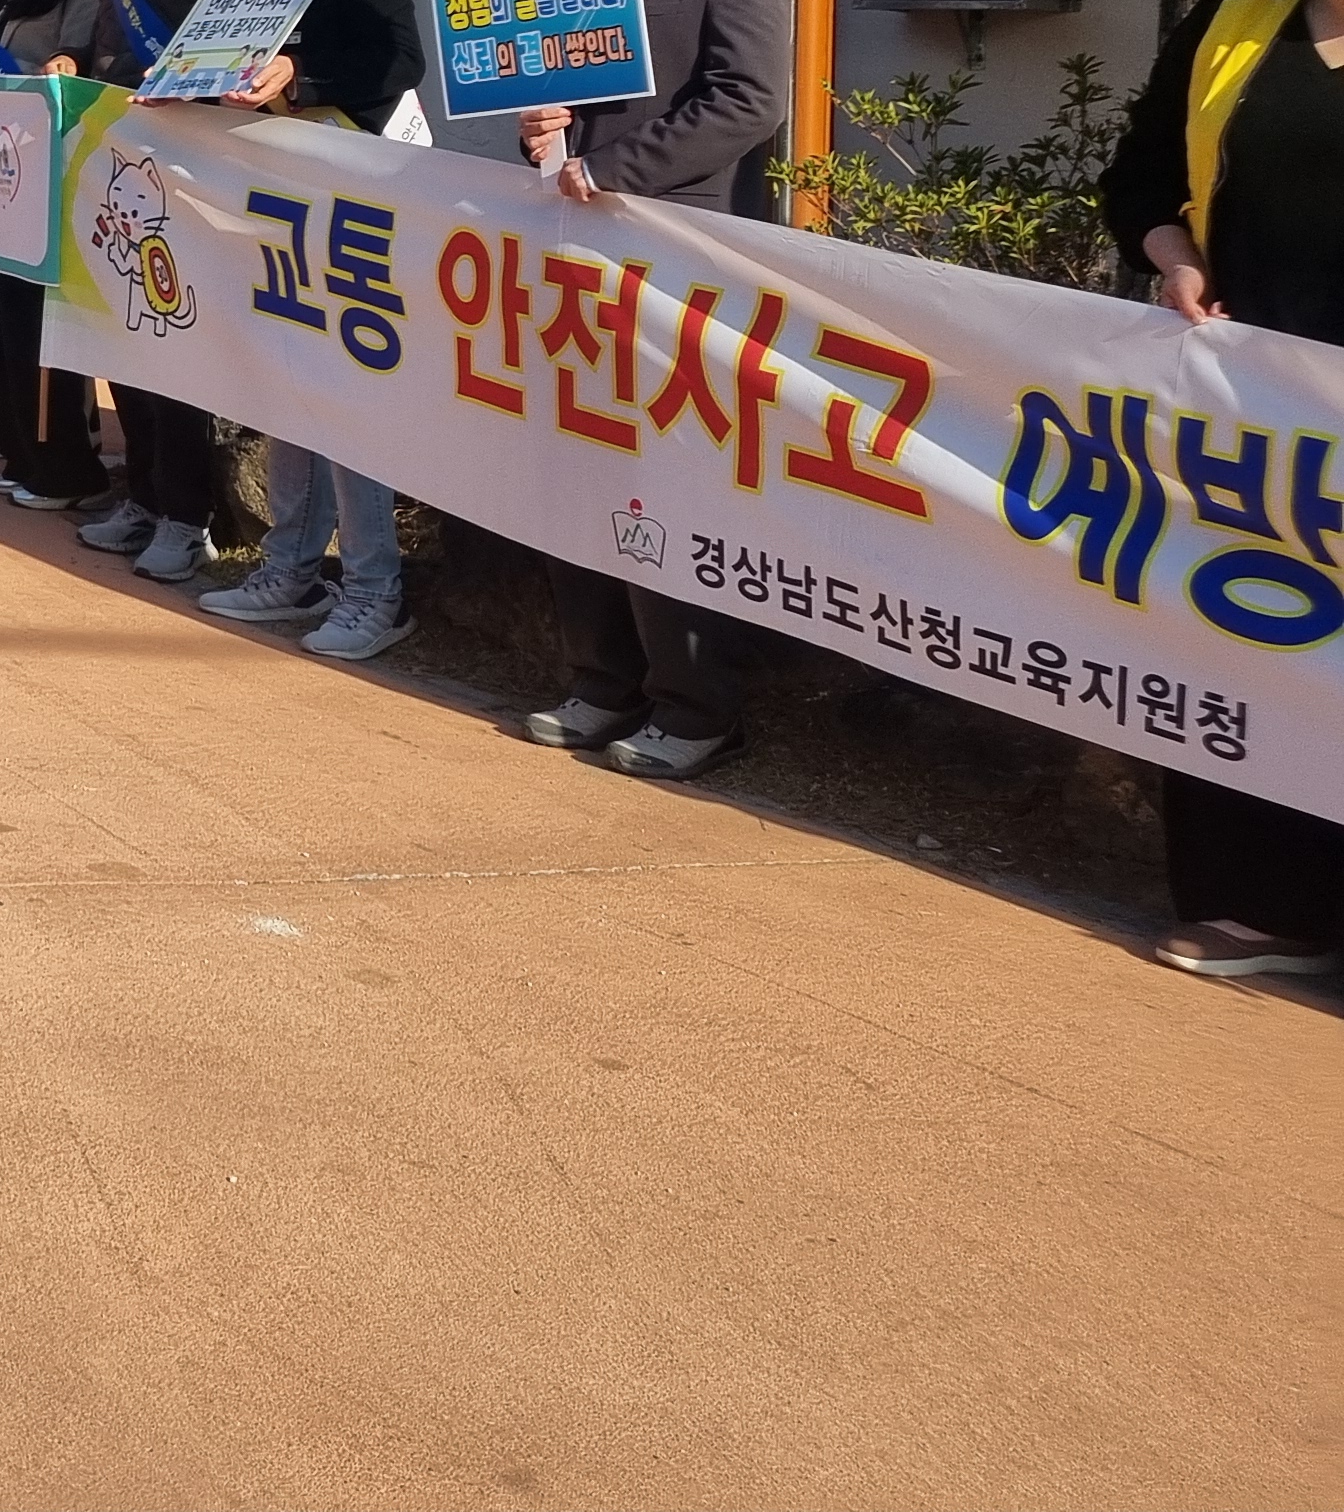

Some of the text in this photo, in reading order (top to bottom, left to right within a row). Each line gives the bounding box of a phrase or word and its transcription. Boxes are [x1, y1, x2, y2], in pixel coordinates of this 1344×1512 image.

[182, 17, 236, 41] 교통질서
[452, 36, 519, 84] 신뢰의
[564, 24, 635, 69] 쌓인다.
[245, 185, 1344, 655] 교통 안전사고 예방
[688, 531, 1251, 764] 경상남도산청교육지원청
